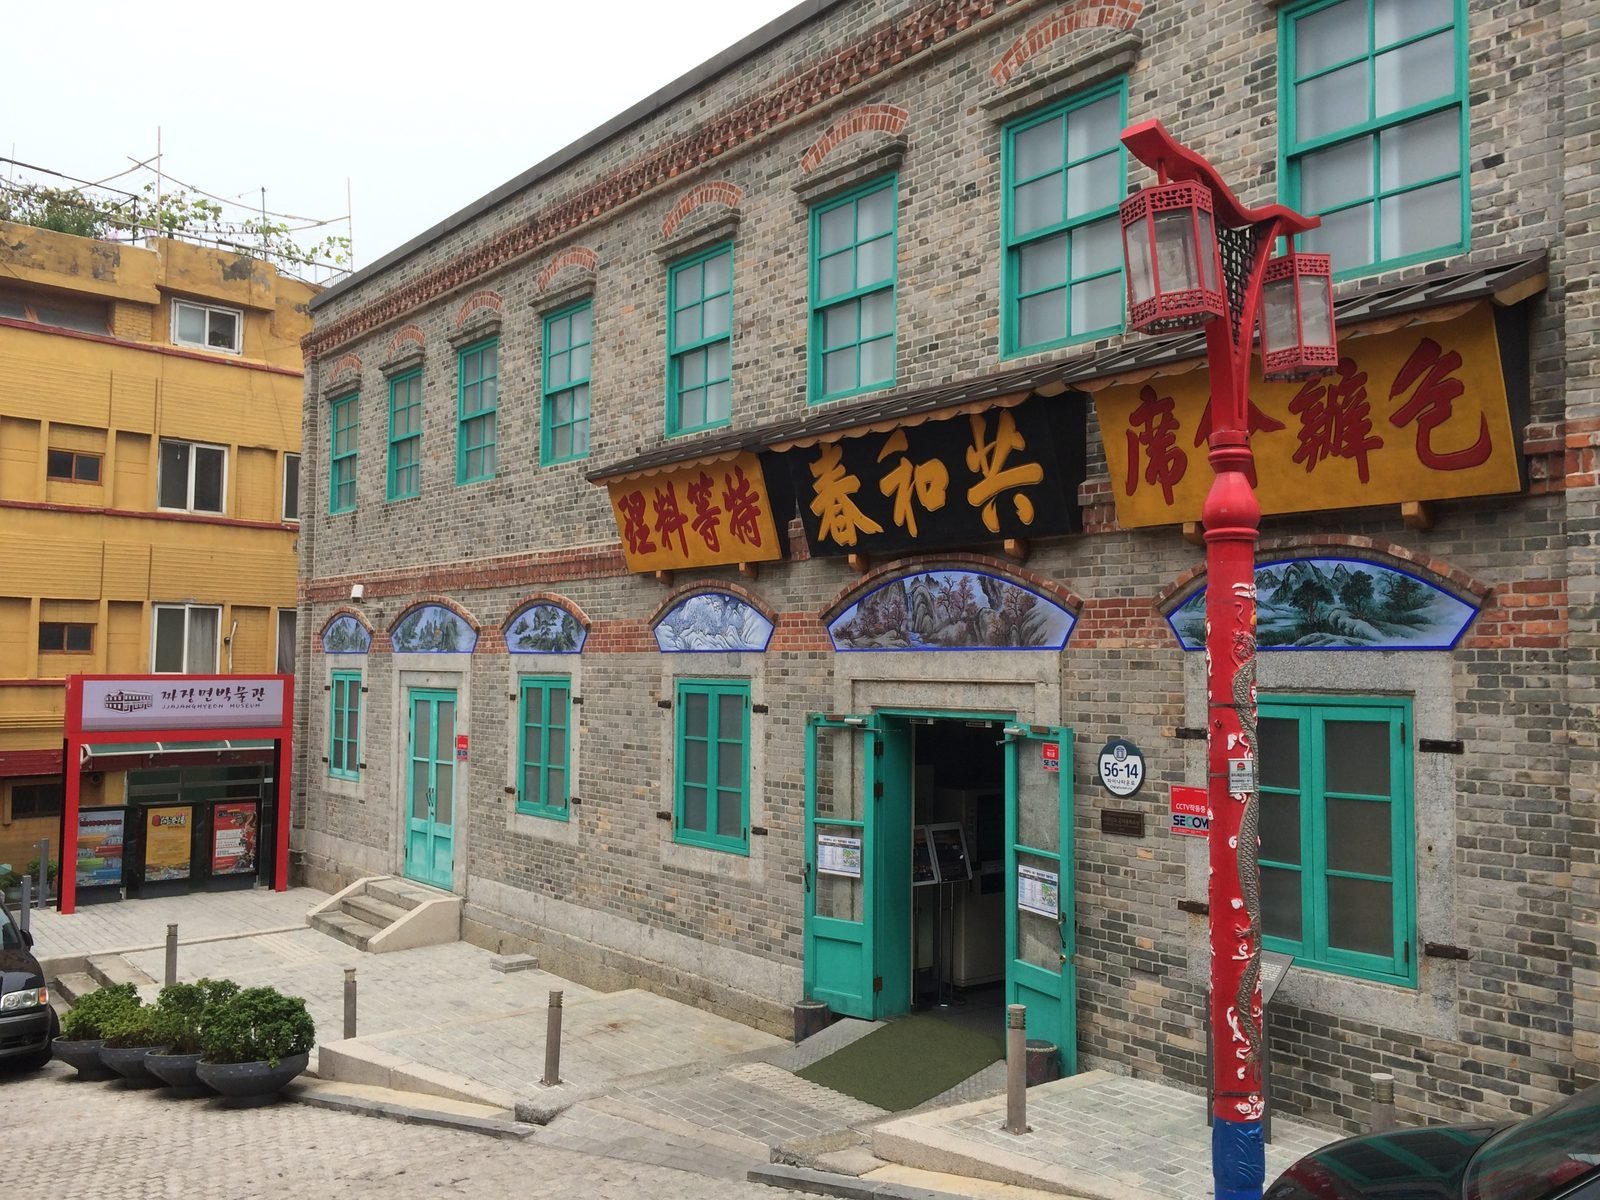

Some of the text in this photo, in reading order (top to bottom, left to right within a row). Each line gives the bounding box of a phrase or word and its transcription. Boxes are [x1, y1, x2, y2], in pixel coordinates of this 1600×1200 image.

[161, 686, 266, 703] 짜장면박물관
[1104, 762, 1139, 778] 56-14
[1173, 814, 1209, 829] SECOM
